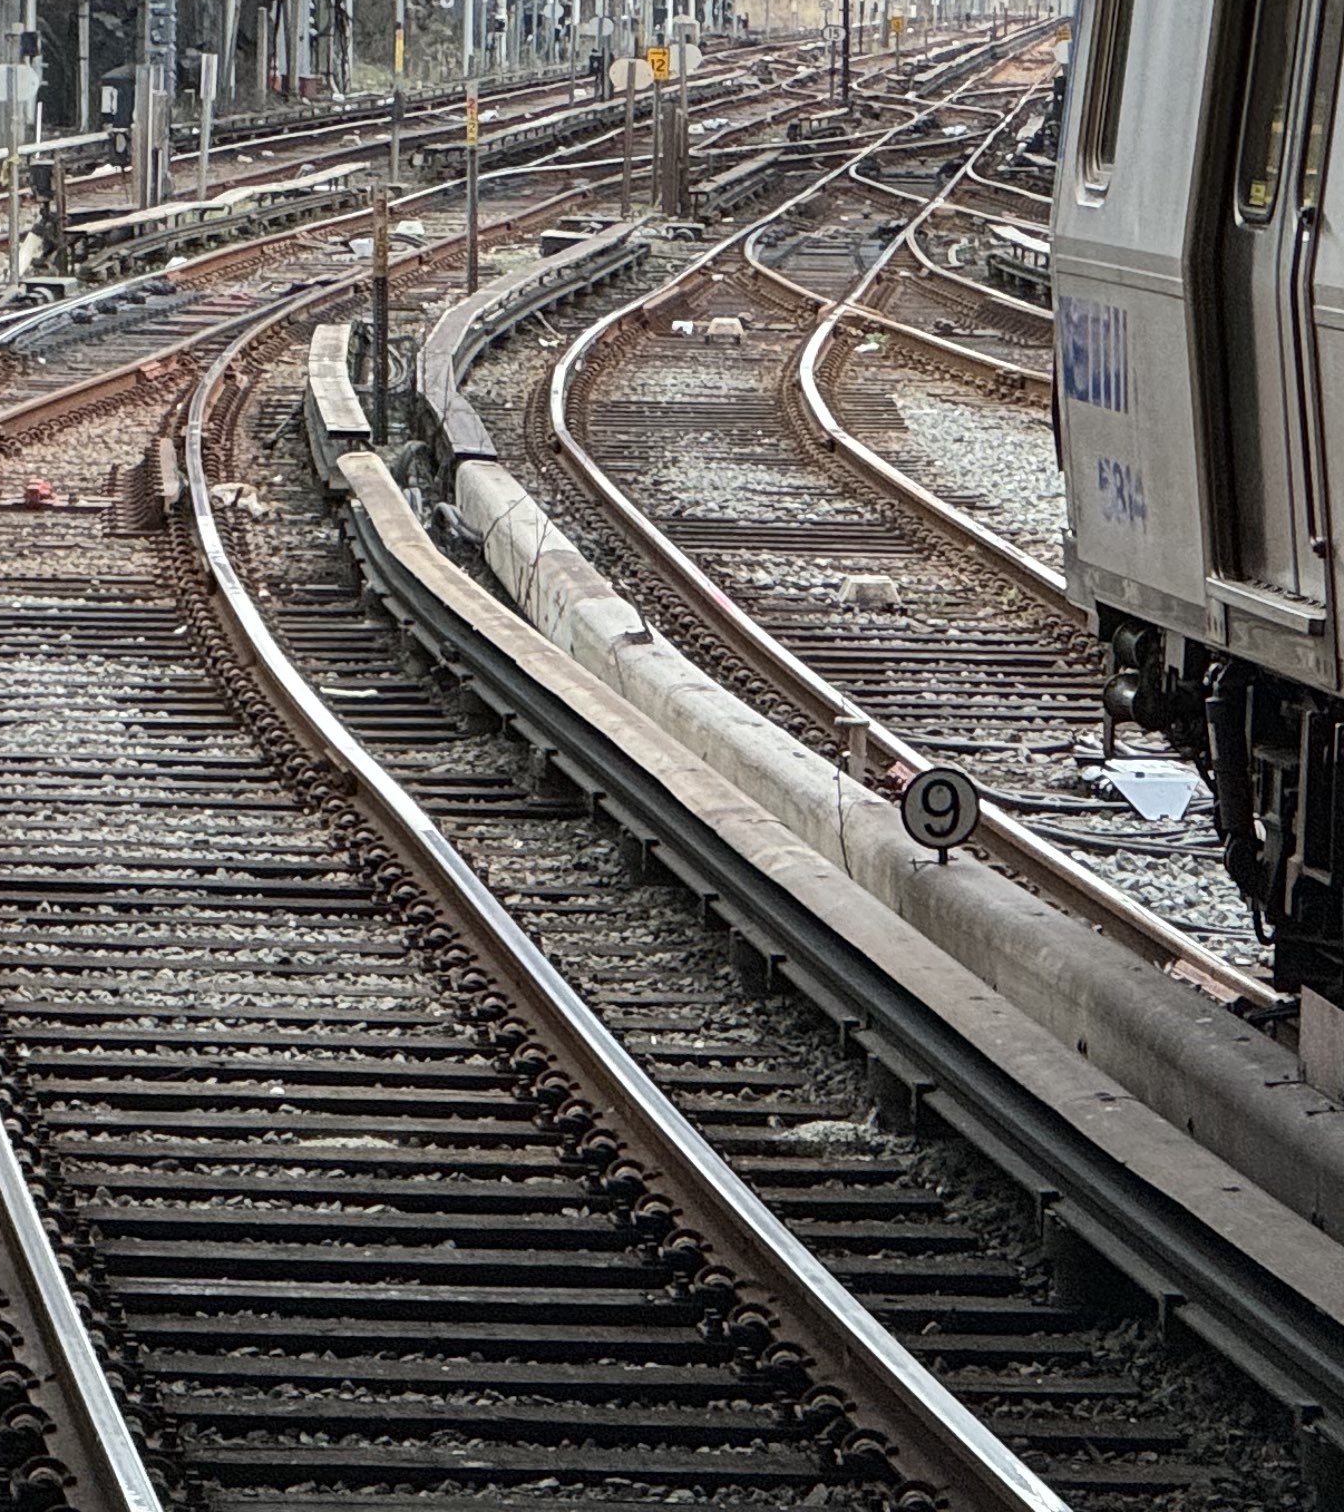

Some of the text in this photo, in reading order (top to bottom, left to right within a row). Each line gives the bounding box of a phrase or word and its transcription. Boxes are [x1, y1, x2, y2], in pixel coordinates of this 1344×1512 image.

[828, 27, 840, 40] 15
[650, 58, 666, 72] 12
[921, 778, 960, 838] 9
